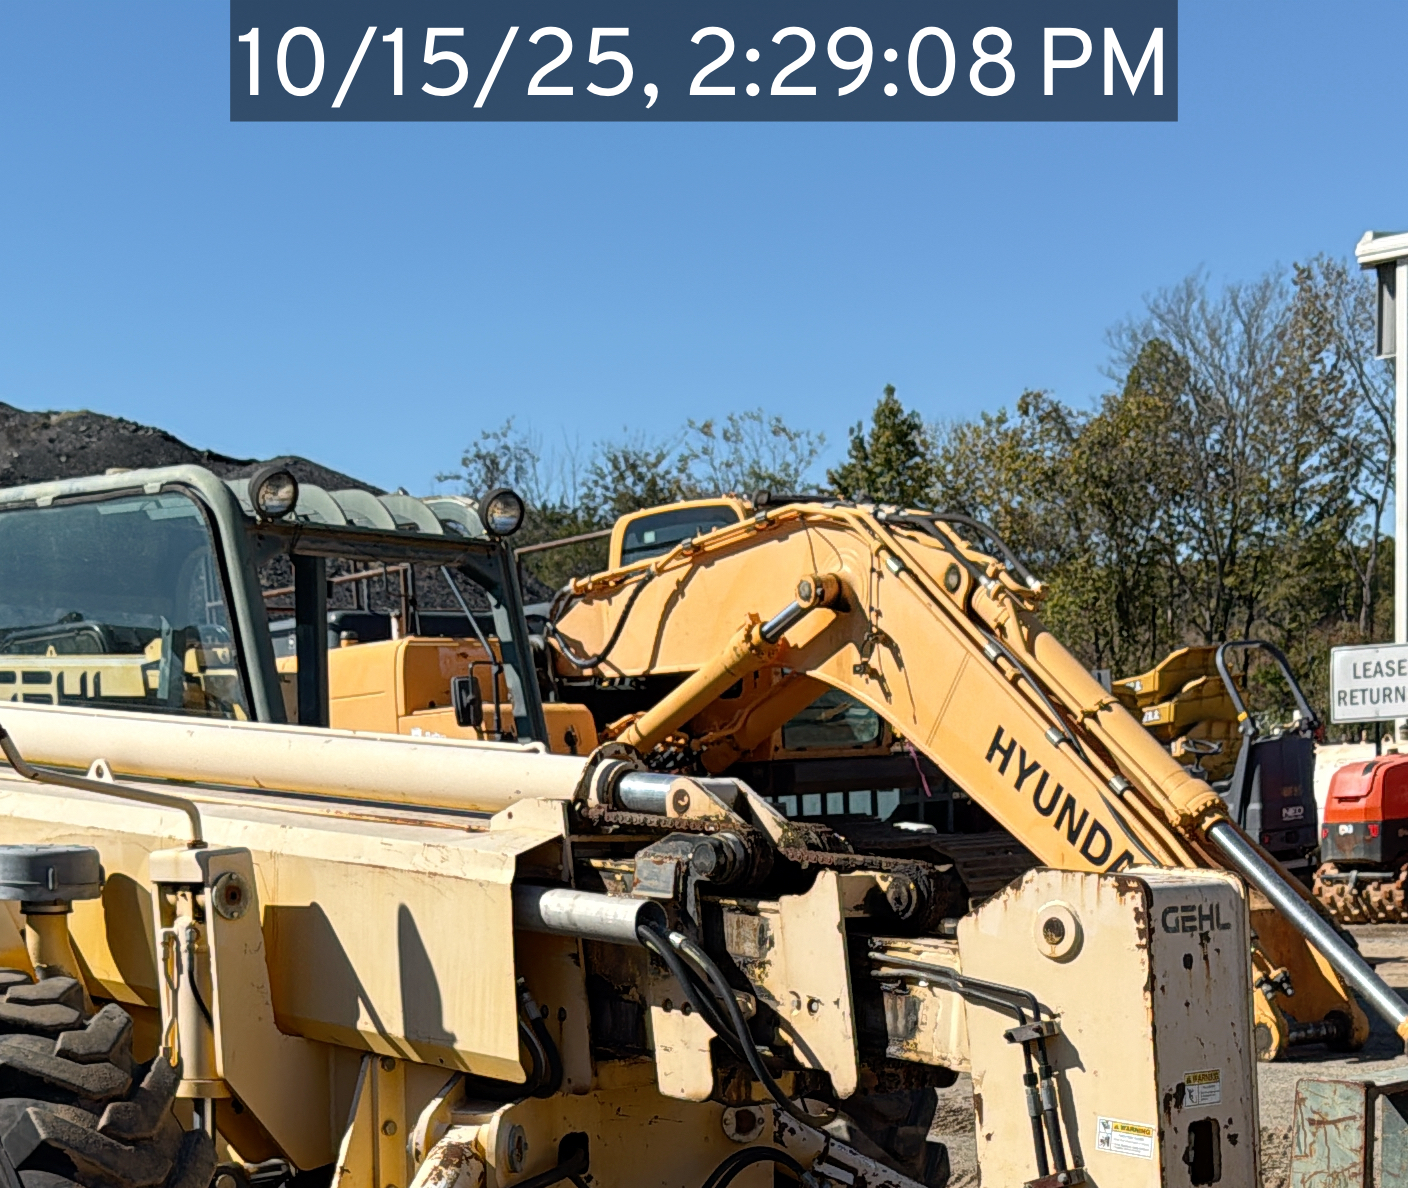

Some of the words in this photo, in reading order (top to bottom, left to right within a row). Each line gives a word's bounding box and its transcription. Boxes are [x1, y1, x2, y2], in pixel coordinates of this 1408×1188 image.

[1352, 659, 1408, 680] LEASE
[1162, 902, 1231, 933] GEHL
[1120, 1124, 1151, 1136] WARNING
